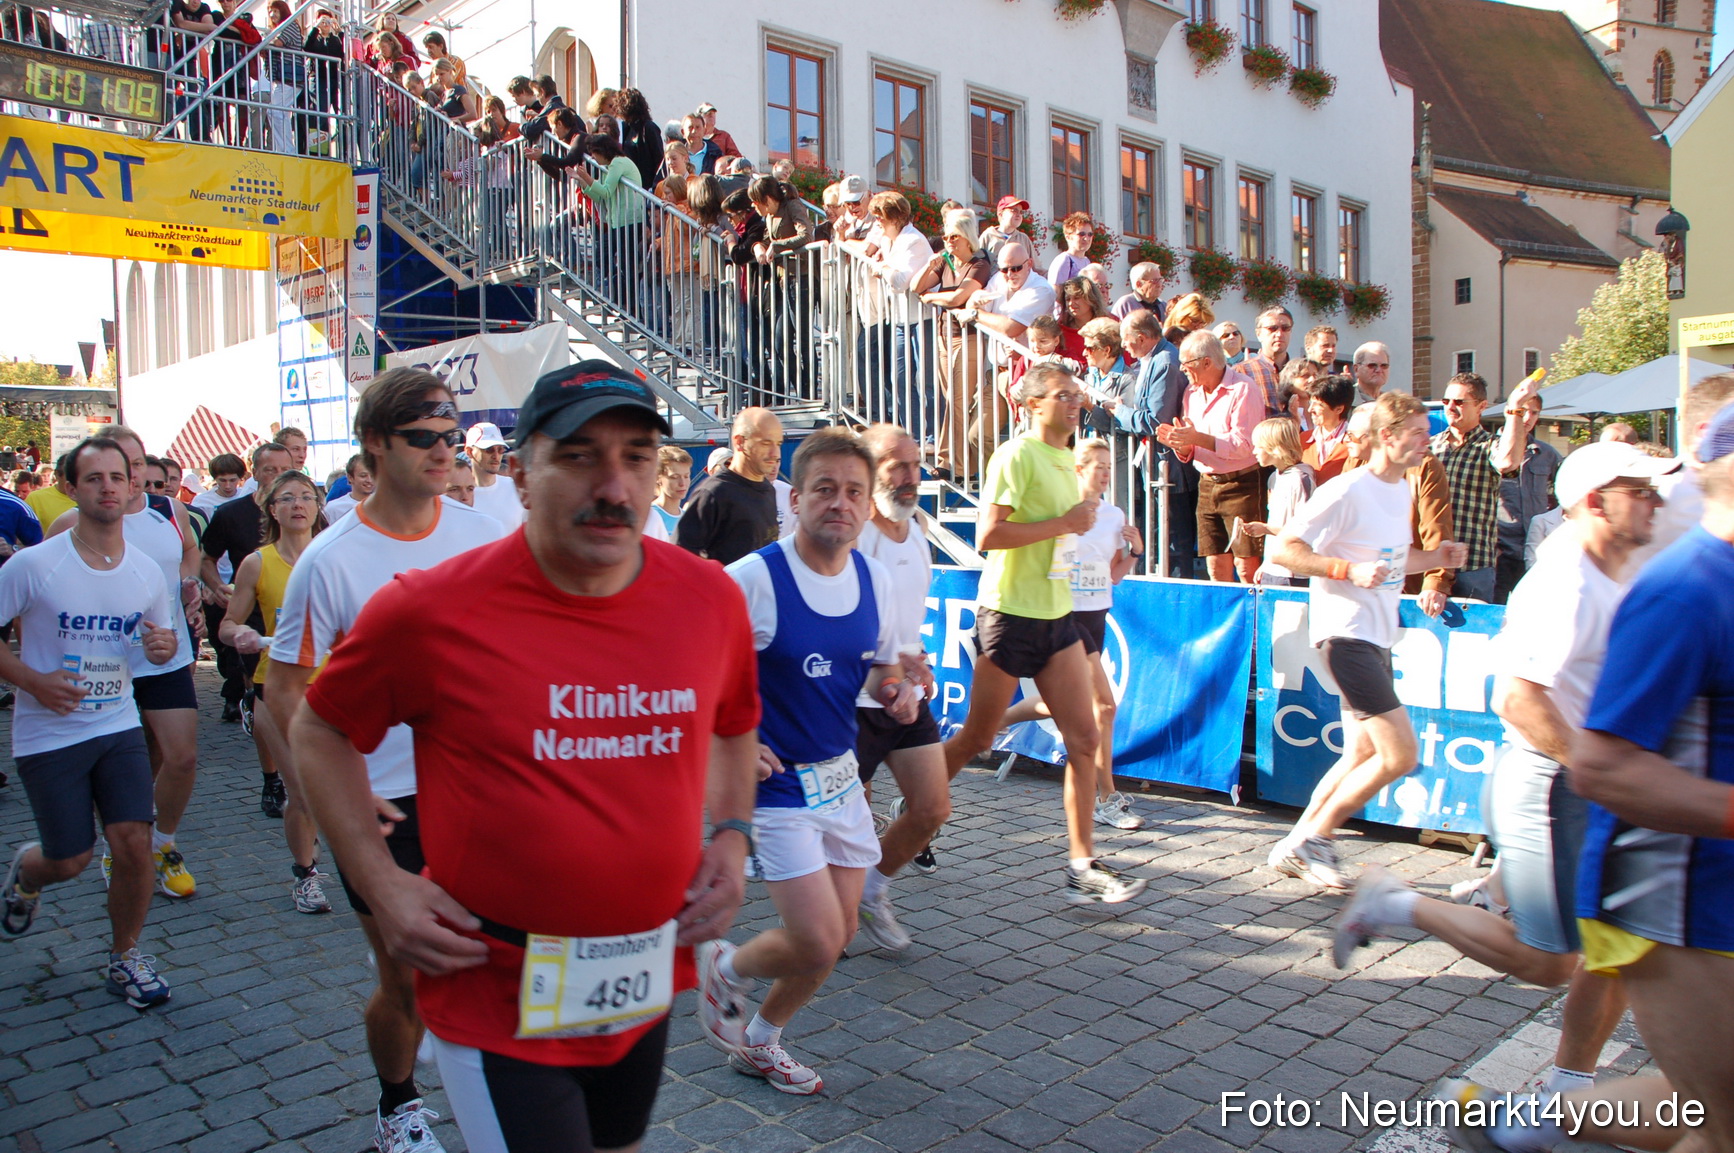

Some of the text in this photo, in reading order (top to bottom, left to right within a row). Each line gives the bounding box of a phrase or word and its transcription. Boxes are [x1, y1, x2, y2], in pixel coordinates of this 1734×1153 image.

[0, 45, 42, 60] ronische
[189, 188, 320, 212] Neumarkter Stadtlauf
[125, 227, 243, 246] Neumarkter Stadtlauf
[58, 611, 123, 632] terra
[80, 634, 95, 643] my
[97, 634, 121, 642] world
[83, 661, 121, 673] Matthias
[83, 680, 123, 696] 2829
[548, 683, 697, 719] Klinikum
[533, 725, 684, 761] Neumarkt
[584, 969, 651, 1011] 480
